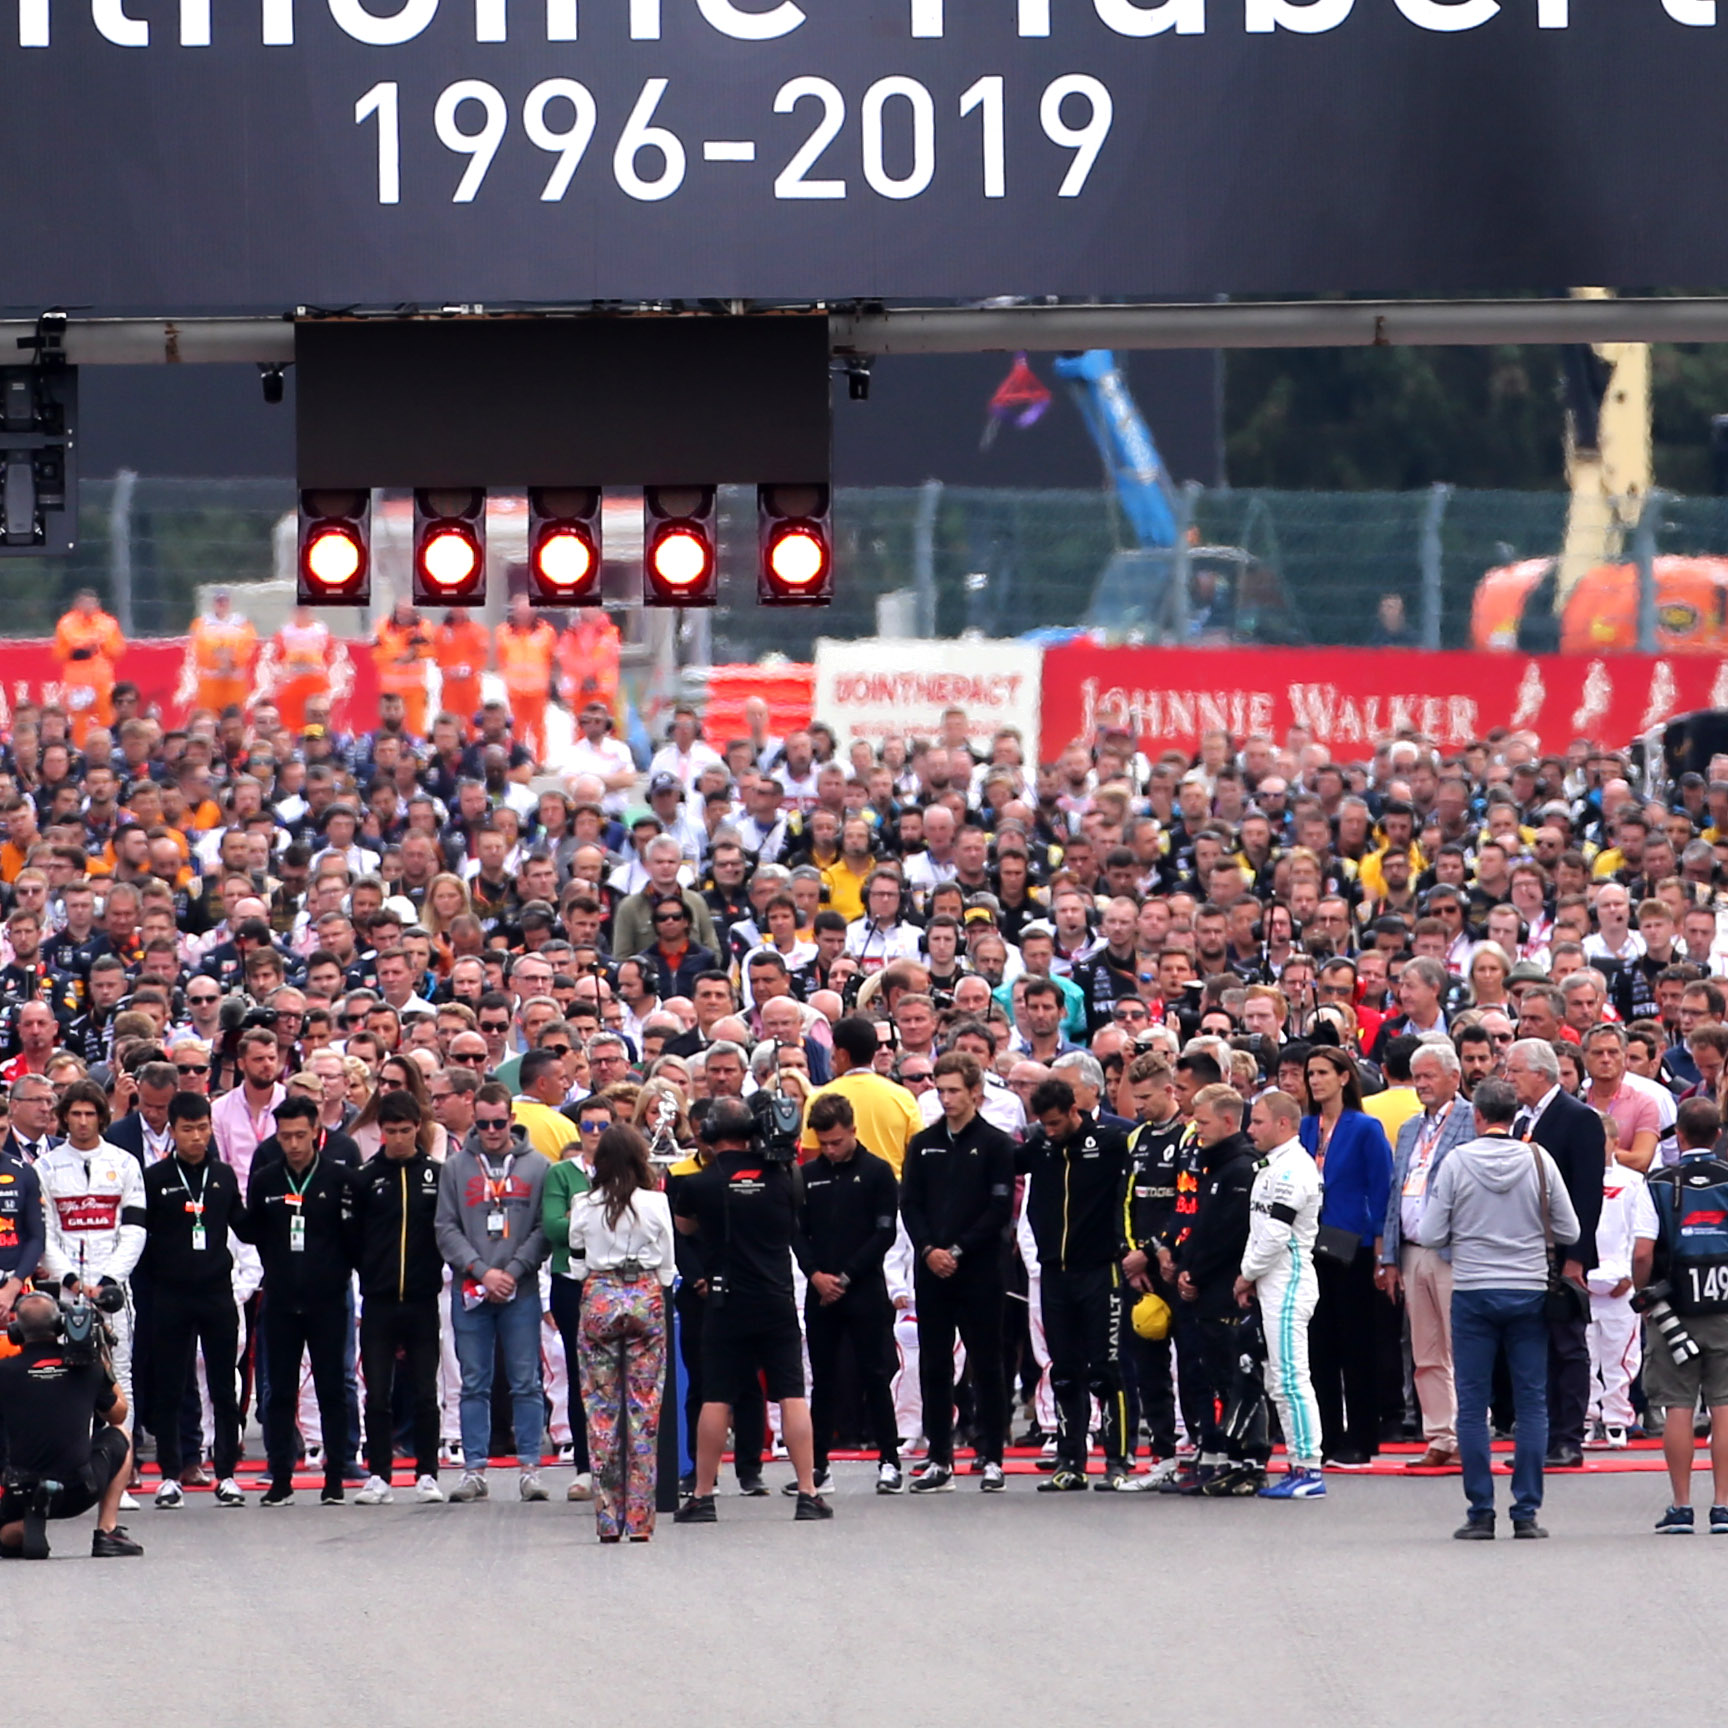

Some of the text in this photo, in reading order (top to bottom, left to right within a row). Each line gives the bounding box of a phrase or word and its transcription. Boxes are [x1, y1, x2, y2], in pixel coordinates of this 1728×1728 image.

[352, 73, 1116, 204] 1996-2019
[1080, 675, 1477, 746] JOHNNIE WALKER
[1108, 1293, 1122, 1362] NAULT
